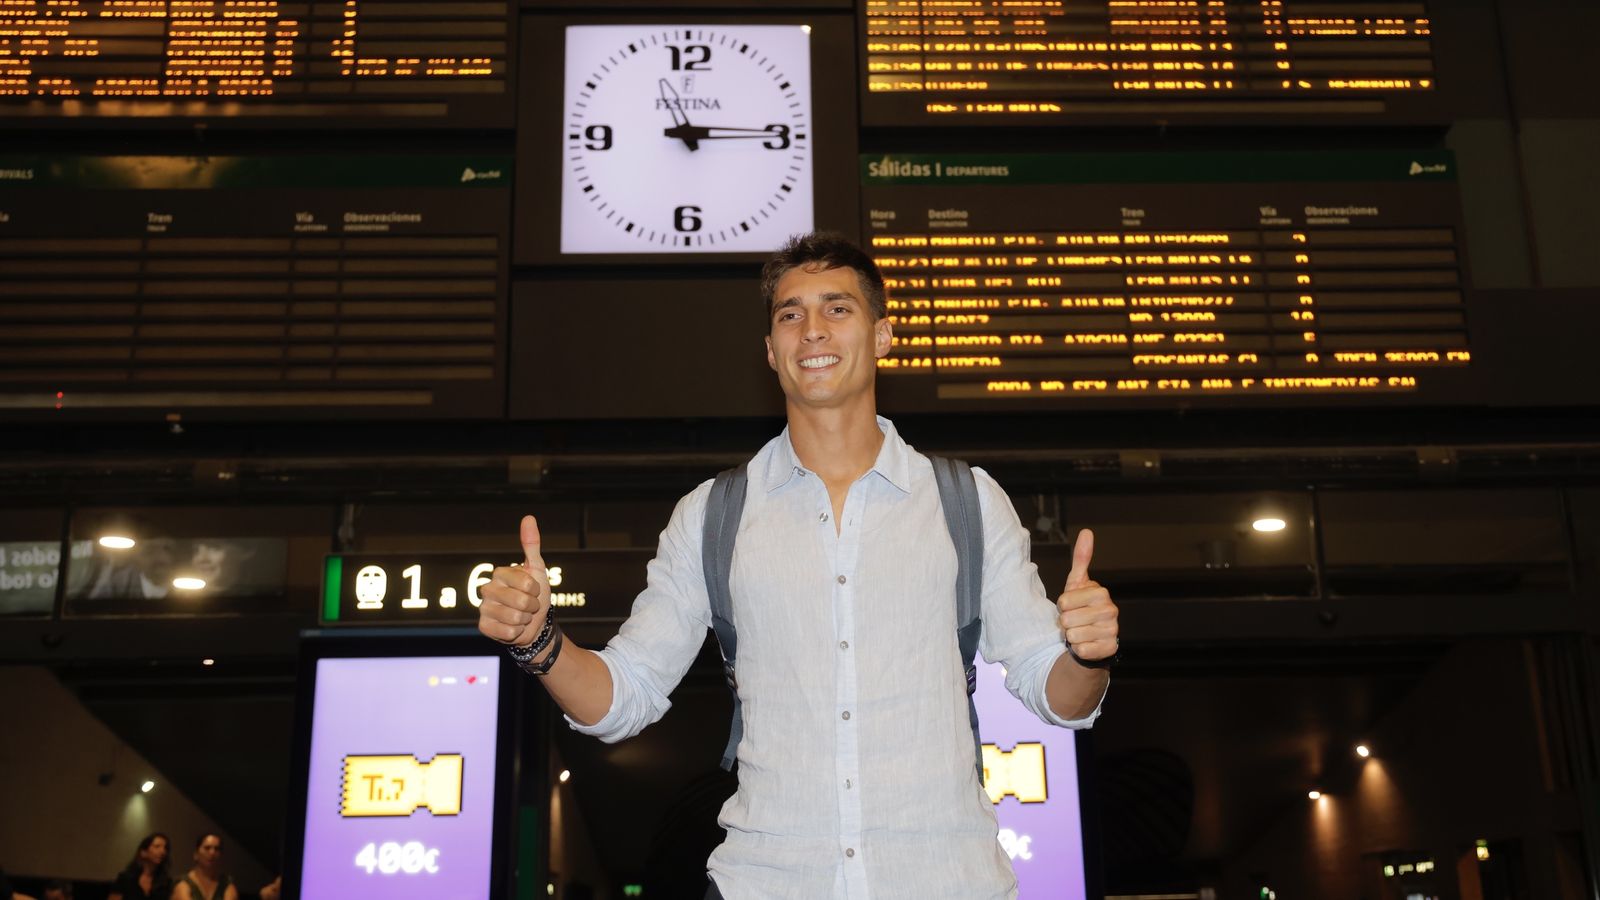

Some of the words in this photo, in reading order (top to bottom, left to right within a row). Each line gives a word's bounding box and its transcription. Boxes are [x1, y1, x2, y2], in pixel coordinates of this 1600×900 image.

[665, 45, 712, 71] 12
[655, 98, 721, 110] FESTINA
[584, 124, 612, 151] 9
[763, 124, 790, 150] 3
[869, 160, 931, 177] Salidas
[945, 166, 1009, 176] DEPARTURES
[673, 205, 703, 232] 6
[870, 209, 896, 220] Hora
[928, 209, 969, 220] Destino
[1121, 207, 1145, 218] Tren
[1304, 206, 1379, 216] Observaciones
[401, 564, 429, 609] 1
[438, 586, 457, 608] a
[466, 562, 494, 608] 6
